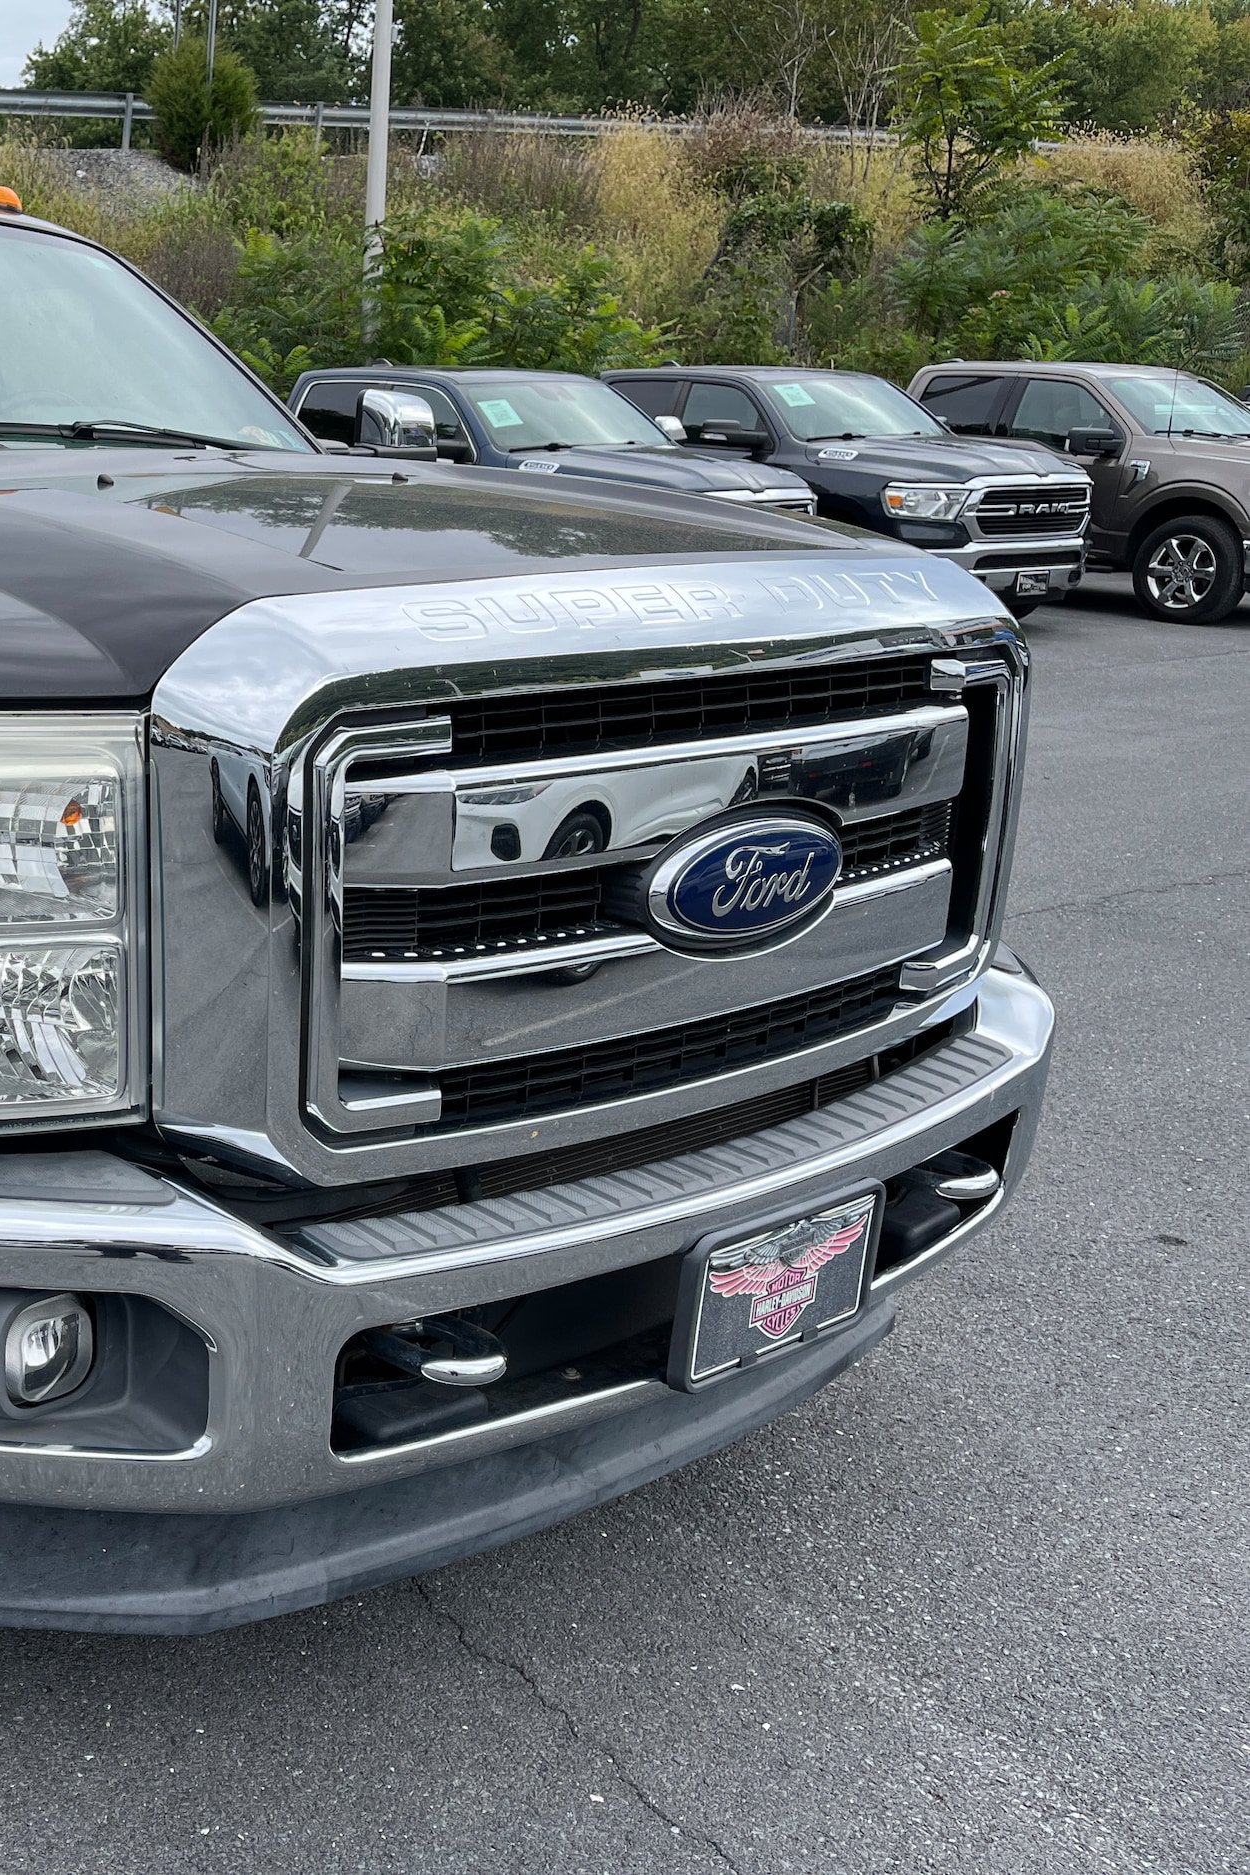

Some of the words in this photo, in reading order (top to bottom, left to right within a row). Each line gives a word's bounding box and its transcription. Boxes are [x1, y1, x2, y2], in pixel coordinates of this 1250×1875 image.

[1019, 503, 1068, 515] RAM
[400, 581, 745, 642] SUPER
[754, 570, 941, 614] DUTY
[712, 841, 815, 918] Ford
[771, 1272, 802, 1293] MOTOR
[756, 1282, 812, 1318] HARLEY-DAVIDSON
[766, 1307, 797, 1331] CYCLES
